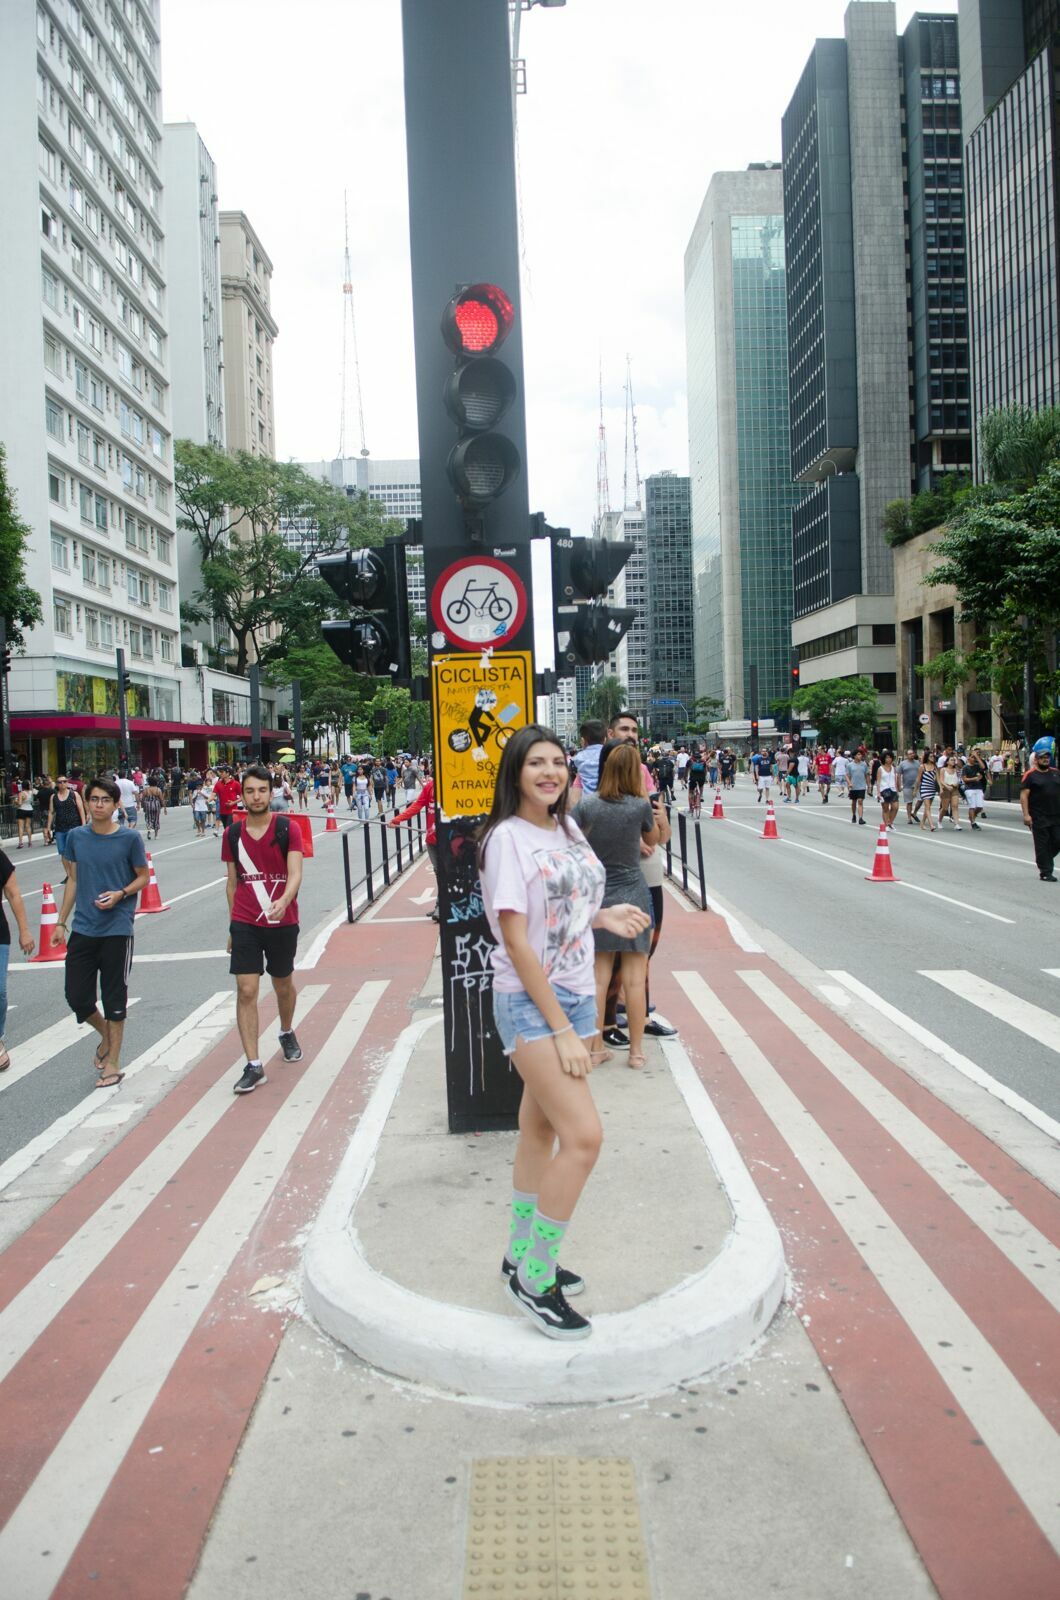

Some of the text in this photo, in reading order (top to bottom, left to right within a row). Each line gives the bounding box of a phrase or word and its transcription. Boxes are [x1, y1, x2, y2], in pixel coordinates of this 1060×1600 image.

[556, 538, 574, 549] 480
[440, 667, 522, 683] CICLISTA
[456, 797, 494, 809] NO VE
